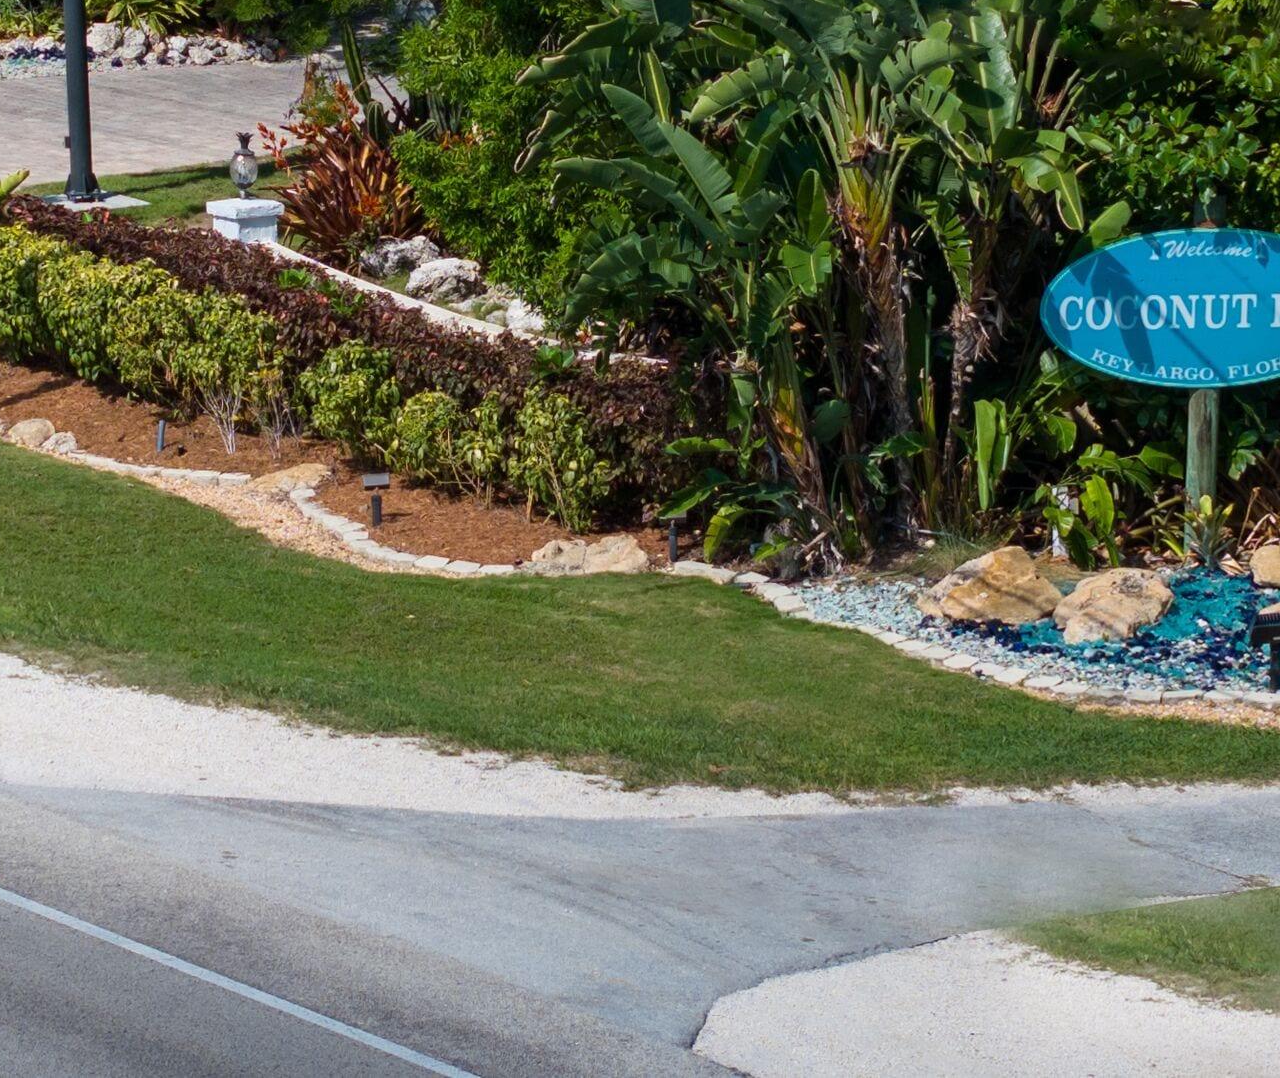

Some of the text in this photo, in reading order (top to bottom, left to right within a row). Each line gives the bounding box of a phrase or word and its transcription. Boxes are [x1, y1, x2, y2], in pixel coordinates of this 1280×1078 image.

[1163, 240, 1253, 259] Welcome
[1059, 293, 1258, 331] COCONUT
[1090, 348, 1135, 372] KEY
[1140, 362, 1221, 382] LARGO,
